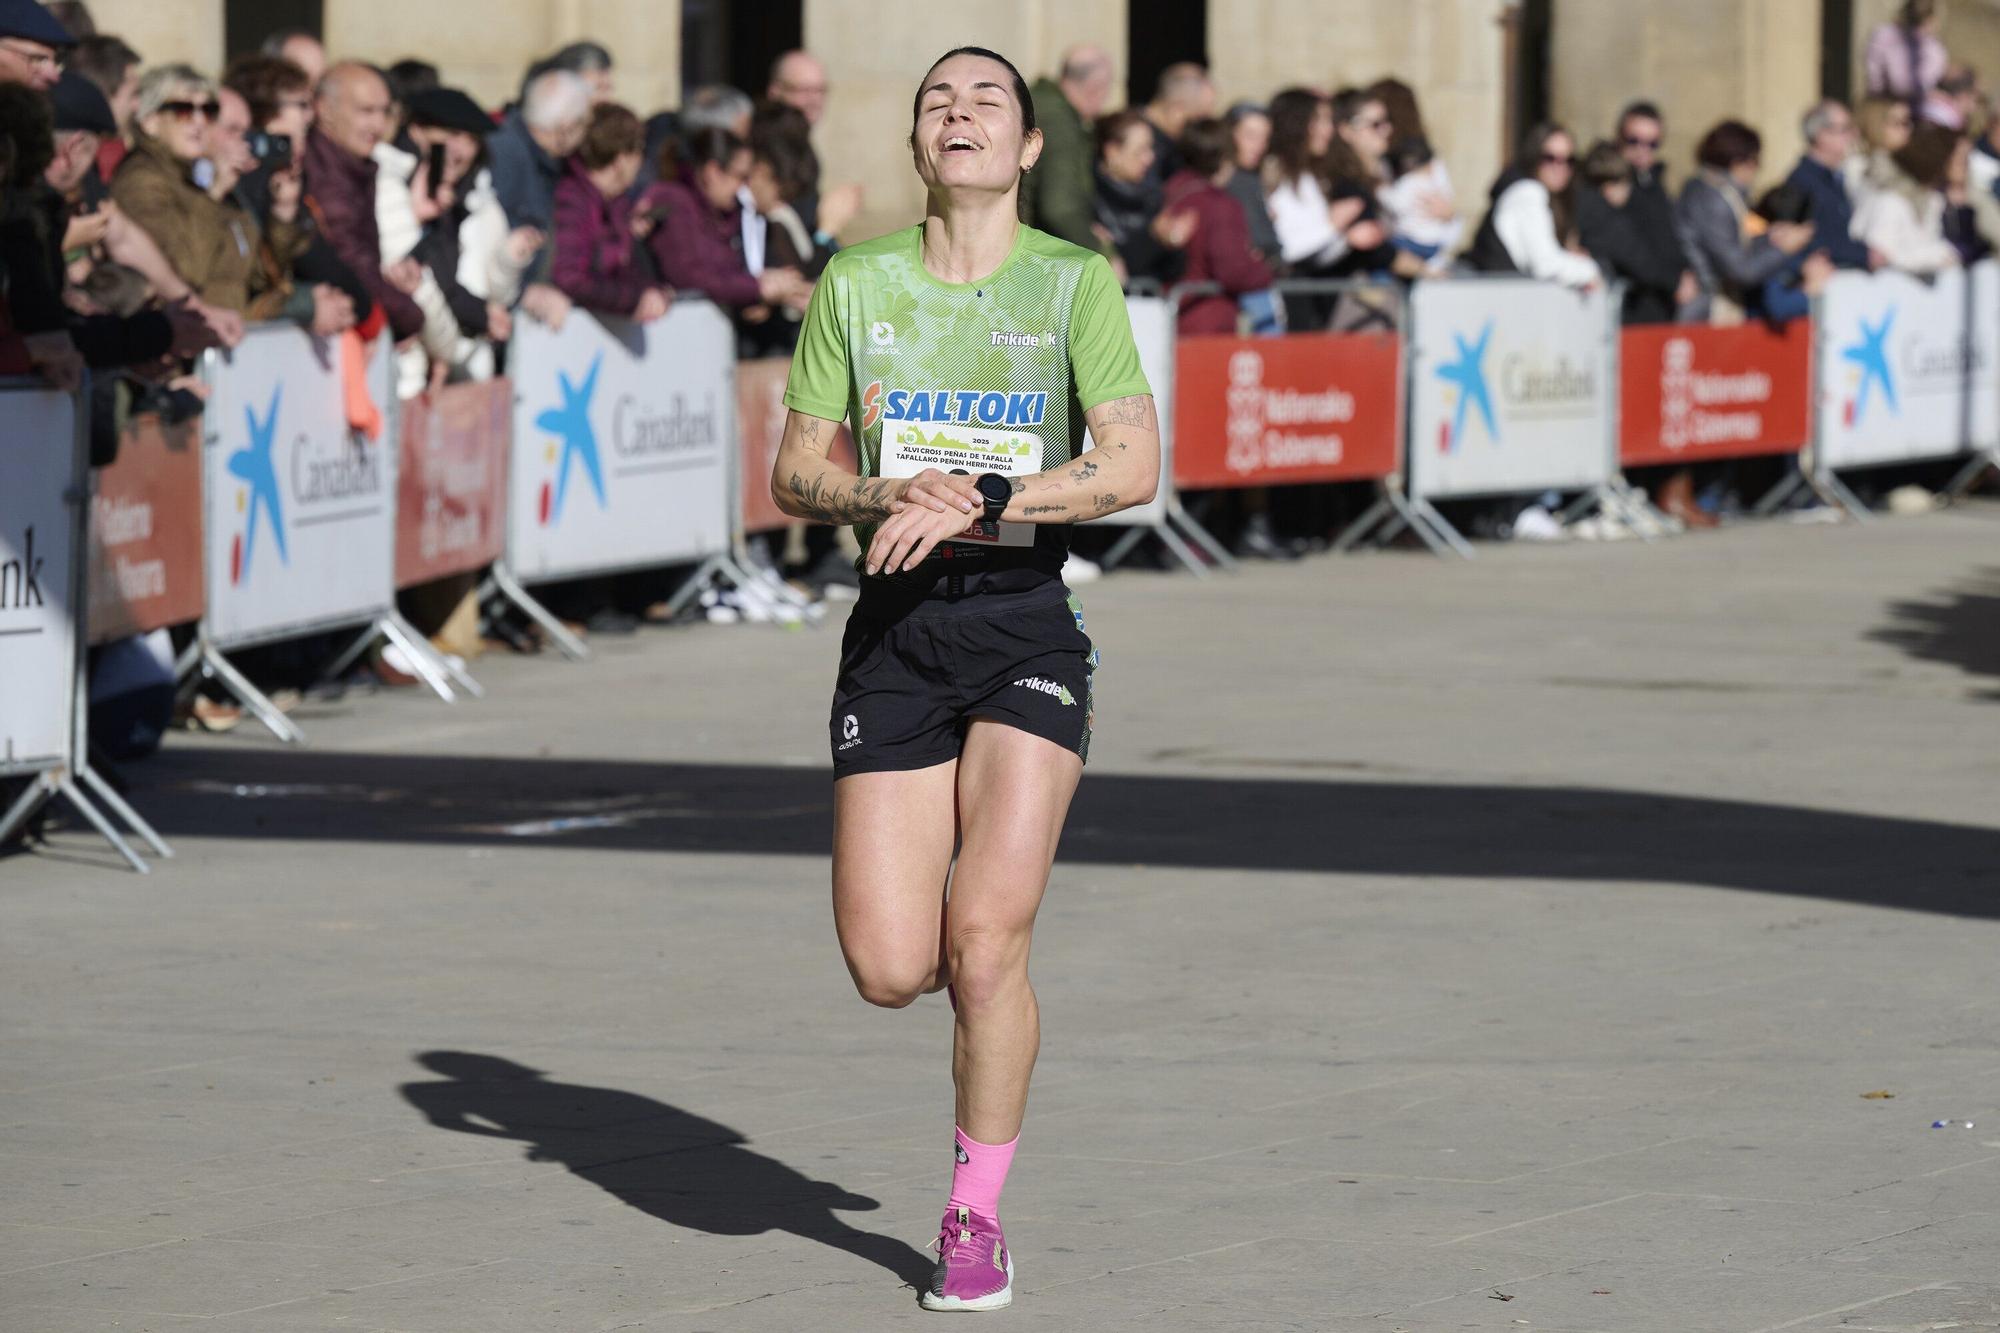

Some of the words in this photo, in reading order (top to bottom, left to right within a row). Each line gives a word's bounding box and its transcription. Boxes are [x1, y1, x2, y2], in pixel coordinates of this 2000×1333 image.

[990, 330, 1056, 350] Trikidek
[883, 390, 1047, 425] SALTOKI
[896, 453, 939, 463] TAFALLAKO
[940, 456, 965, 466] PEÑEN
[966, 460, 988, 468] HERRI
[989, 463, 1013, 471] KROSA
[903, 446, 920, 454] XLVI
[920, 447, 942, 456] CROSS
[944, 448, 967, 458] PEÑAS
[970, 452, 980, 460] DE
[982, 454, 1013, 463] TAFALLA
